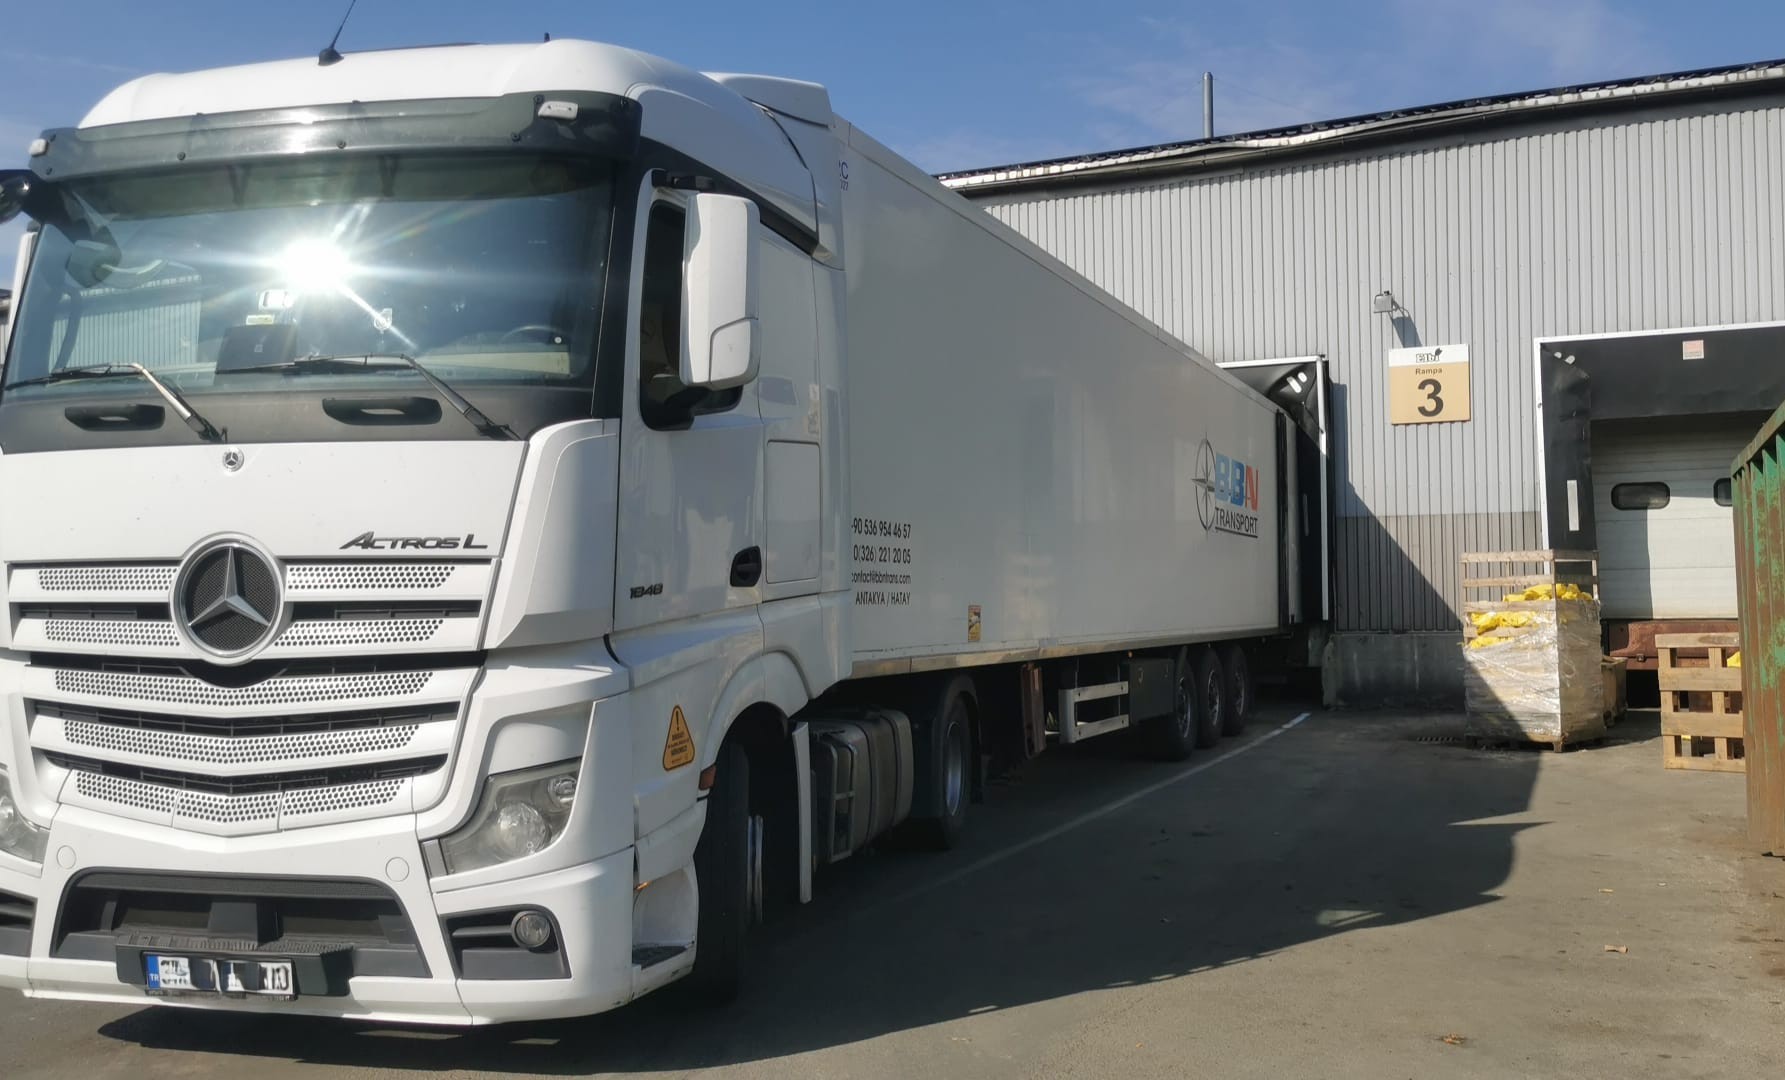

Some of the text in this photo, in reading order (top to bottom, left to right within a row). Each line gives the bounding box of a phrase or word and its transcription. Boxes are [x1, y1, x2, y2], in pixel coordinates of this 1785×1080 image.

[839, 160, 848, 179] C
[1418, 378, 1444, 417] 3
[1215, 452, 1258, 512] BBN
[864, 519, 877, 536] 536
[879, 521, 891, 536] 954
[893, 522, 902, 538] 46
[903, 524, 911, 538] 57
[1215, 506, 1258, 534] TRANSPORT
[463, 534, 488, 549] L
[879, 546, 890, 562] 221
[893, 548, 901, 564] 20
[903, 548, 911, 564] 05
[856, 592, 885, 605] ANTAKYA
[891, 592, 911, 605] HATAY
[150, 974, 159, 982] TR
